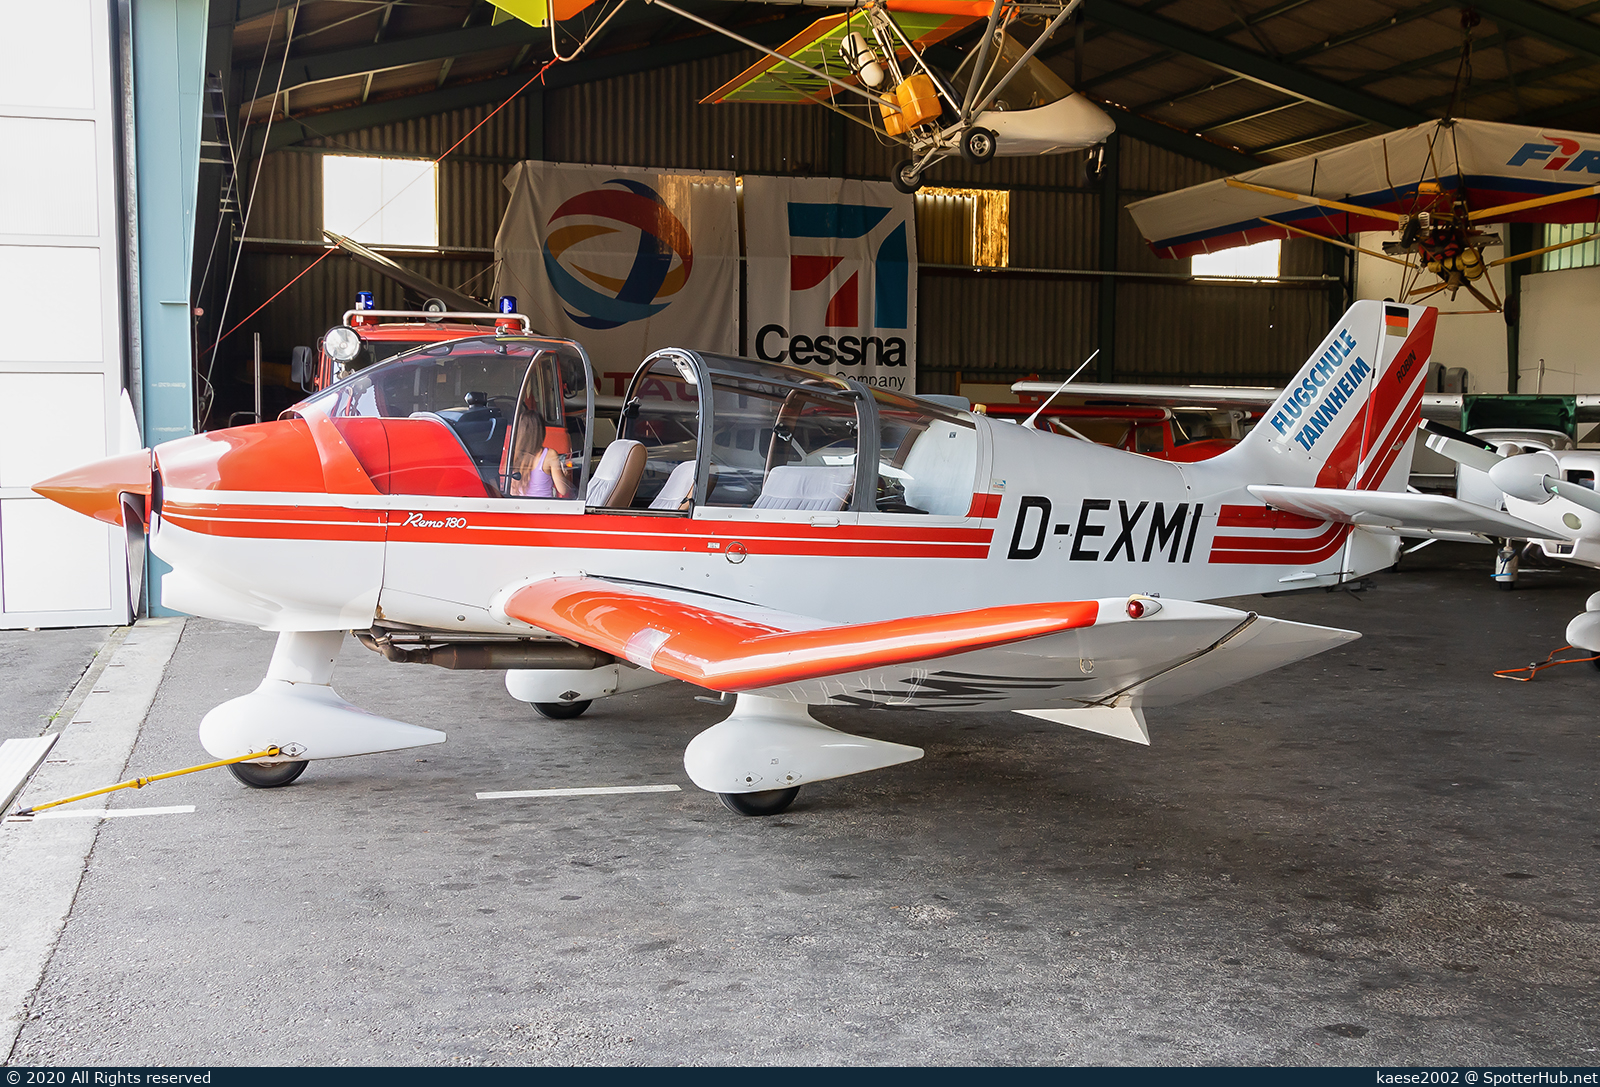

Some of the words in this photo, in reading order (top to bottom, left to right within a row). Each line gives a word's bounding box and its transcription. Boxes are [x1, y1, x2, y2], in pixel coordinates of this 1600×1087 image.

[755, 324, 907, 367] Cessna
[1396, 350, 1417, 384] ROBIN
[1270, 328, 1357, 436] FLUGSCHULE
[1294, 356, 1371, 451] TANNHEIM
[402, 512, 445, 528] Remo
[444, 517, 467, 529] 180
[1007, 496, 1204, 563] D-EXMI
